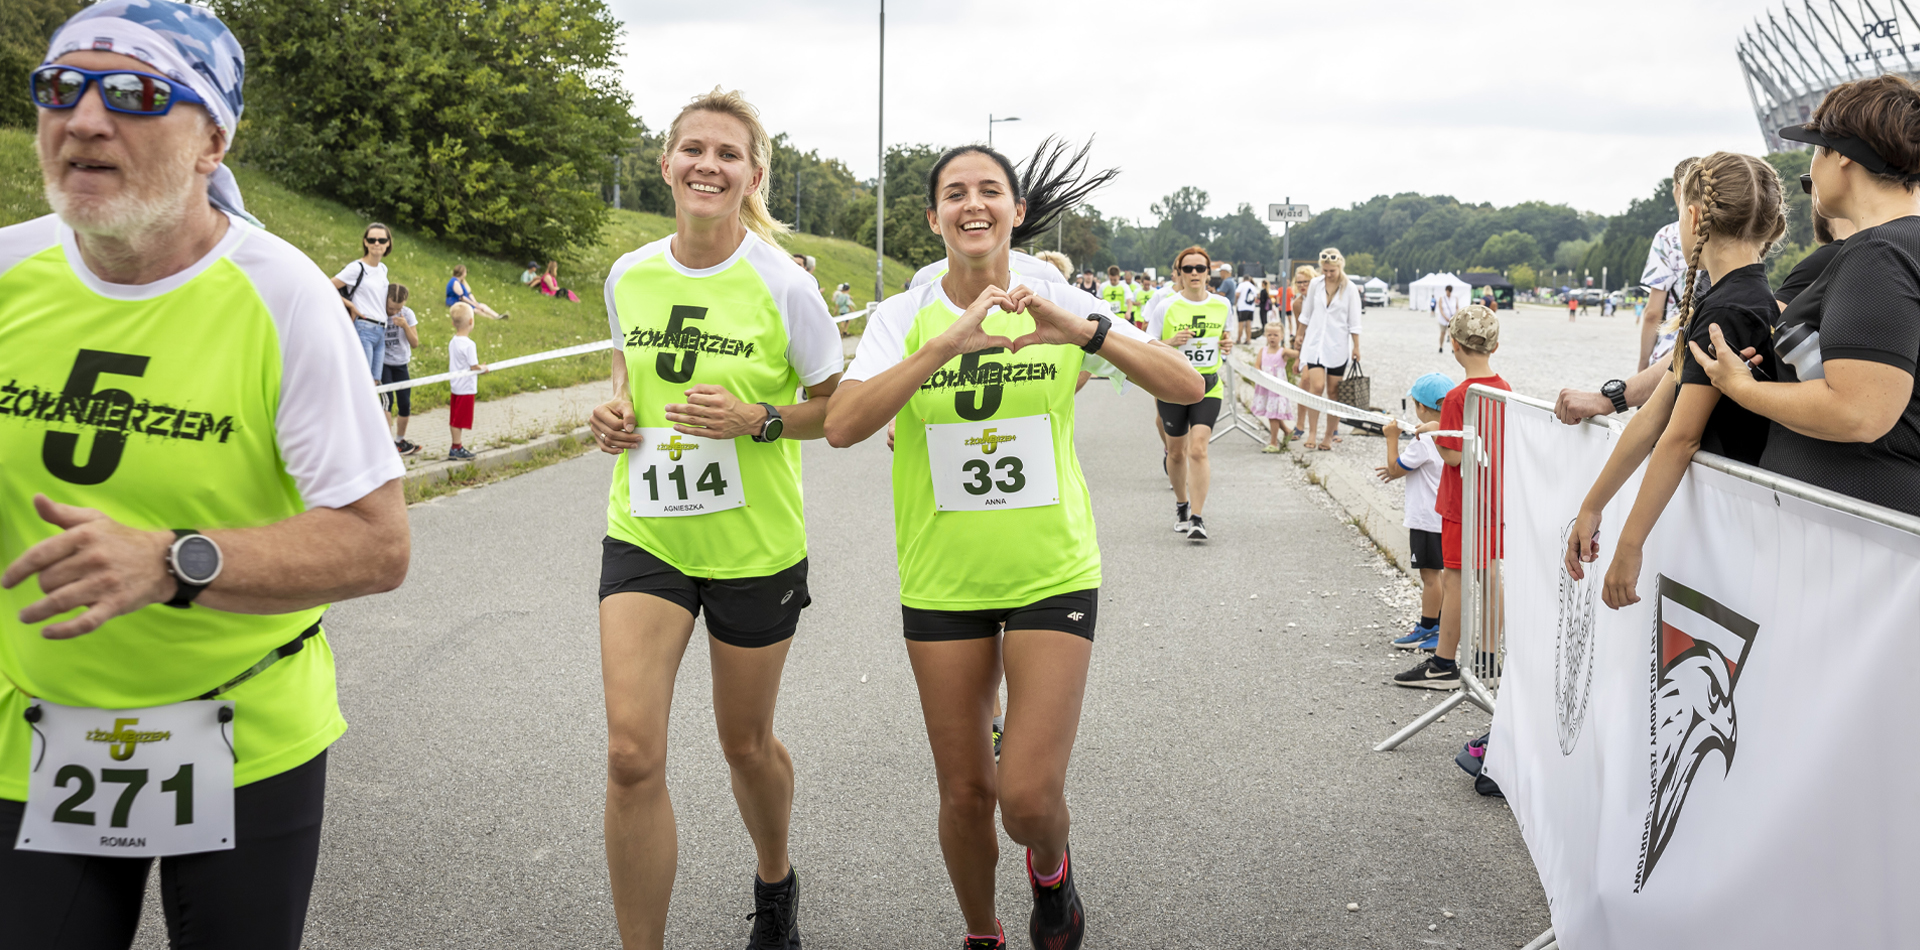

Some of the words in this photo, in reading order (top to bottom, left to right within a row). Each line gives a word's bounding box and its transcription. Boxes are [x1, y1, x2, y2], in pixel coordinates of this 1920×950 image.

[1276, 208, 1303, 219] Wjazd
[655, 305, 708, 383] 5
[1184, 349, 1215, 362] 567
[954, 347, 1004, 421] 5
[42, 348, 151, 485] 5
[642, 462, 728, 501] 114
[962, 456, 1026, 496] 33
[663, 503, 704, 512] AGNIESZKA
[985, 498, 1007, 506] ANNA
[1067, 611, 1085, 621] 4F
[52, 763, 194, 828] 271
[100, 837, 146, 847] ROMAN
[1633, 811, 1653, 894] SPORTOWY
